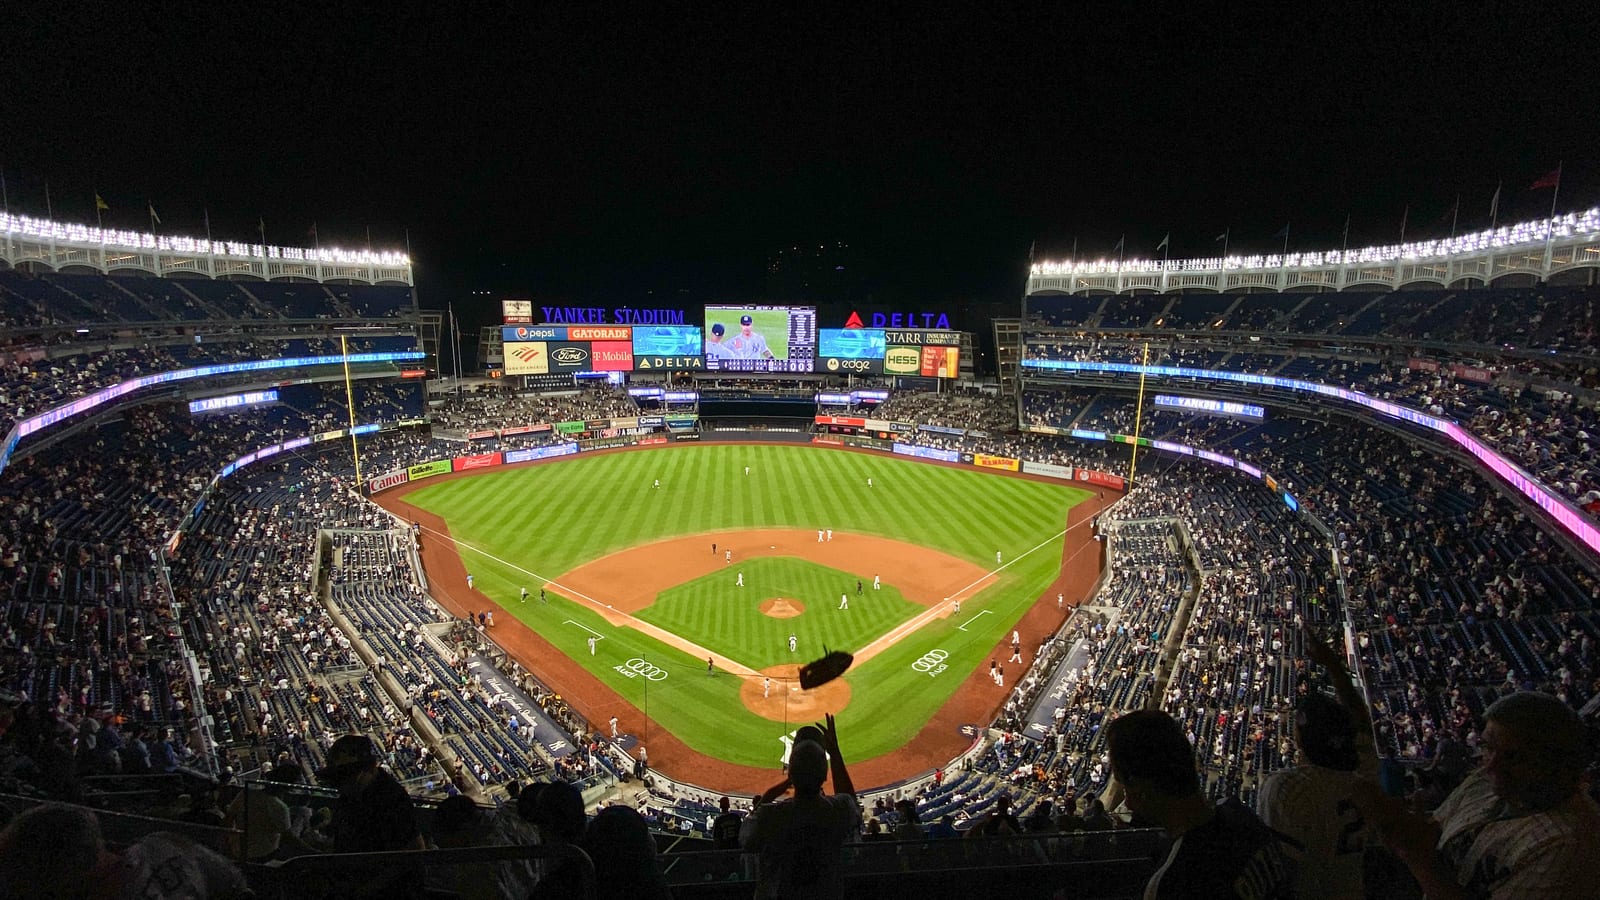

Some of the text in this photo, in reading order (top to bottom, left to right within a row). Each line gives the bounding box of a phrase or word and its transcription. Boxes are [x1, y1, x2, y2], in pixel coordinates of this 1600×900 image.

[541, 306, 685, 325] YANKEE STADIUM
[872, 312, 950, 328] DELTA
[529, 328, 555, 339] pepsi
[572, 329, 628, 339] GATORADE
[886, 332, 922, 344] STARR
[558, 348, 581, 361] Ford
[888, 355, 917, 365] HESS
[655, 358, 701, 368] DELTA
[841, 359, 870, 372] edge
[411, 465, 433, 475] Gillette
[370, 471, 407, 491] Canon
[613, 665, 638, 679] Audi
